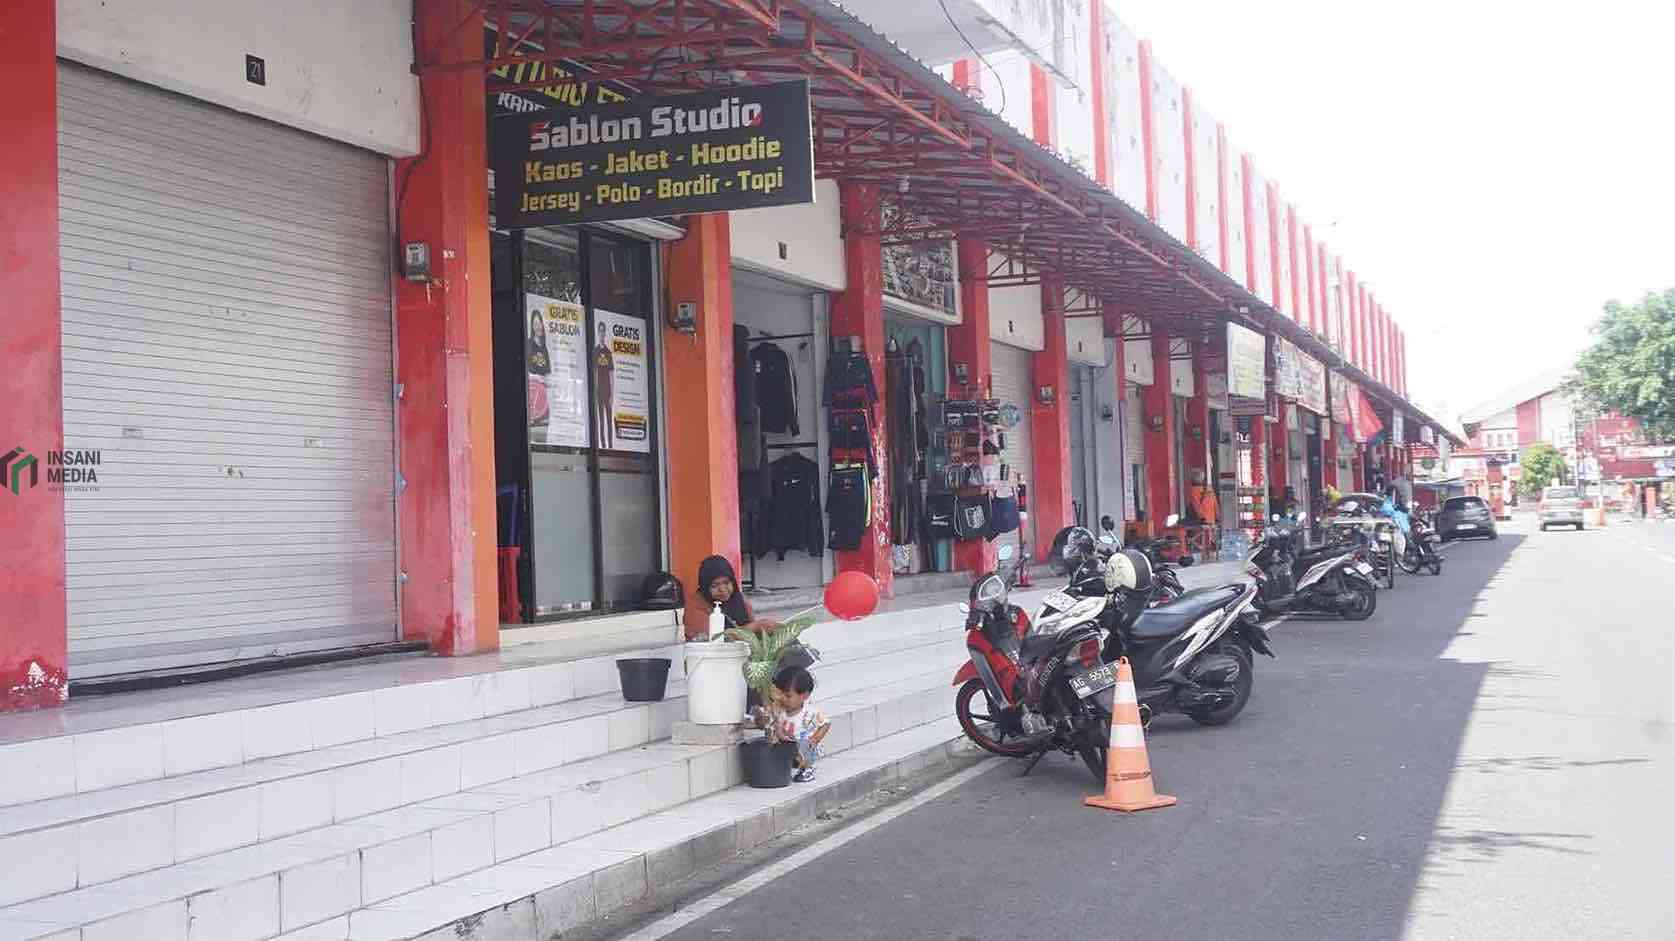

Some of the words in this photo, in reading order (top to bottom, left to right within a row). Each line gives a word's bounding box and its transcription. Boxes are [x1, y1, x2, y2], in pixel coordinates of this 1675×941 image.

[530, 114, 642, 151] Sablon
[651, 97, 764, 138] Studio
[525, 161, 583, 184] Kaos
[605, 150, 669, 174] Jaket
[691, 136, 781, 166] Hoodie
[520, 192, 580, 212] Jersey
[597, 182, 640, 204] Polo
[658, 174, 720, 199] Bordir
[737, 166, 783, 194] Topi
[550, 306, 579, 320] GRATIS
[612, 324, 640, 340] GRATIS
[613, 341, 641, 355] DESIGN
[1072, 679, 1086, 690] AG
